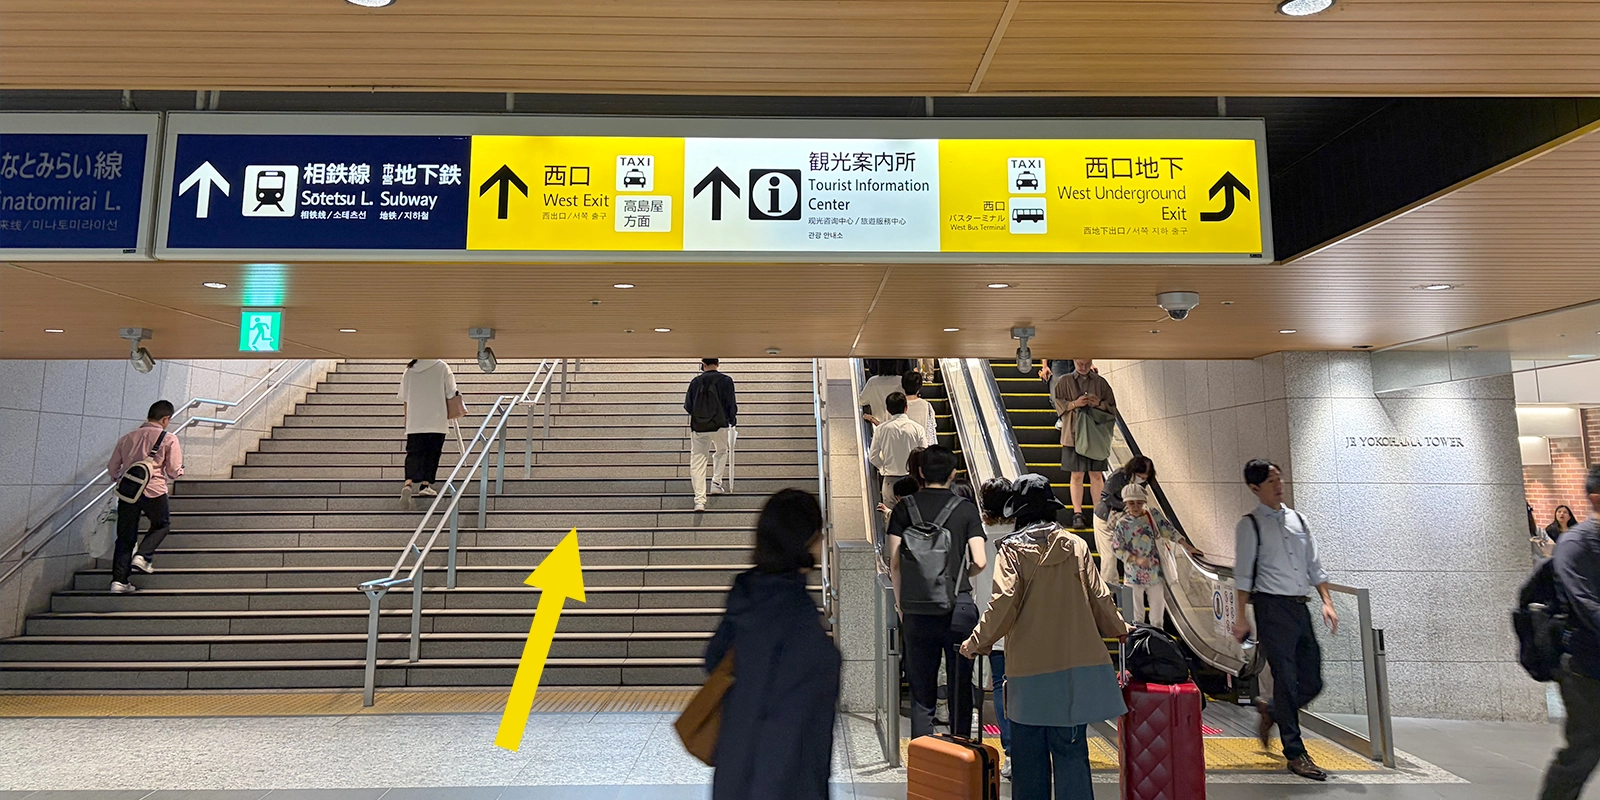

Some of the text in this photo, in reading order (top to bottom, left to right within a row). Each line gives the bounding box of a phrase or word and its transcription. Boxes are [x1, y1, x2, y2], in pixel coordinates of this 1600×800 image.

[1, 151, 123, 180] なとみらい線
[620, 157, 651, 167] TAXI
[809, 151, 916, 172] 観光案内所
[1011, 159, 1041, 169] TAXI
[1085, 157, 1184, 179] 西口地下
[303, 162, 371, 185] 相鉄線
[544, 165, 590, 187] 西口
[808, 178, 930, 191] Tourist Information
[0, 190, 121, 211] natomirai L.
[301, 190, 373, 206] Sōtetsu L.
[380, 191, 438, 210] Subway
[543, 193, 610, 208] West Exit
[1057, 185, 1187, 204] West Underground
[624, 200, 664, 213] 高島屋
[808, 197, 851, 211] Center
[983, 201, 1006, 211] 西口
[949, 214, 1006, 223] バスターミナル
[1161, 206, 1187, 221] Exit
[624, 215, 651, 228] 方面
[1424, 436, 1464, 448] TOWER
